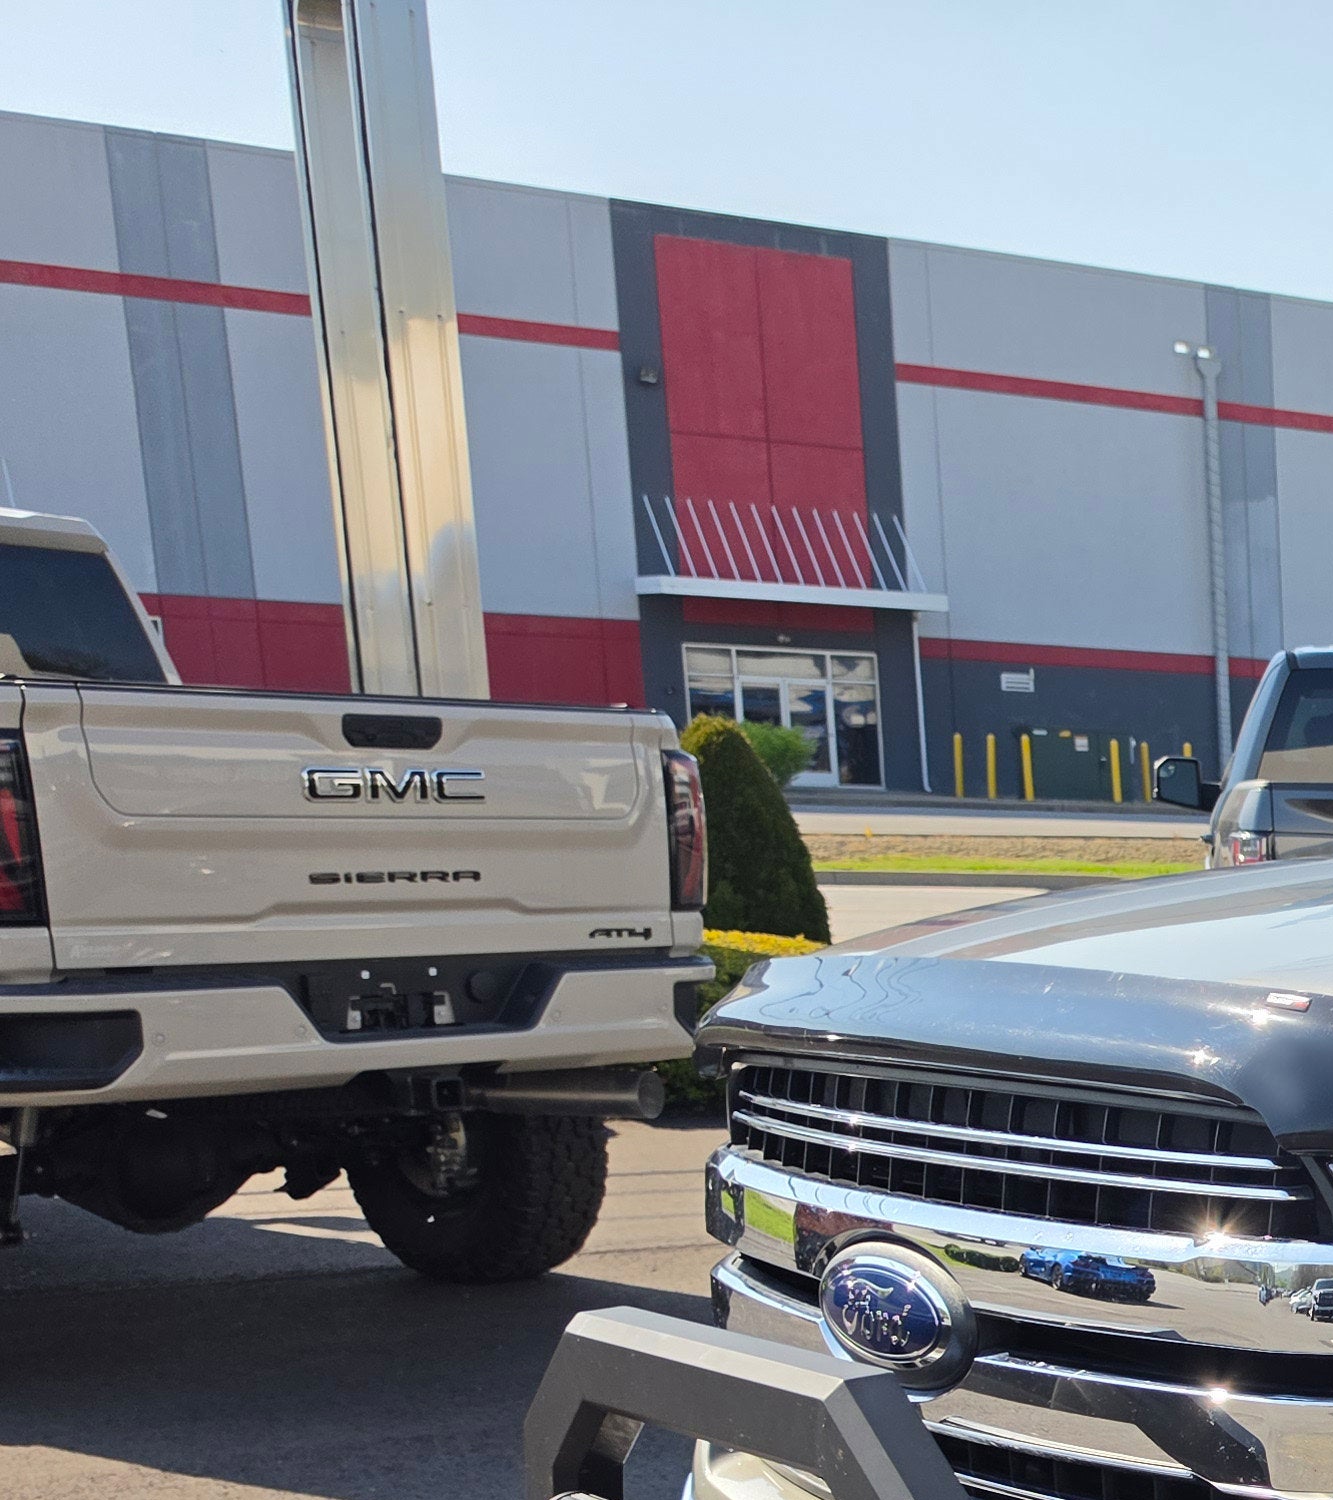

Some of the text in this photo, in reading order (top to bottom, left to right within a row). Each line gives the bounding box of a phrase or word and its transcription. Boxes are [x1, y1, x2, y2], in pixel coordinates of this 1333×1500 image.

[301, 766, 486, 803] GMC
[308, 870, 482, 885] SIERRA
[588, 926, 652, 941] AT4
